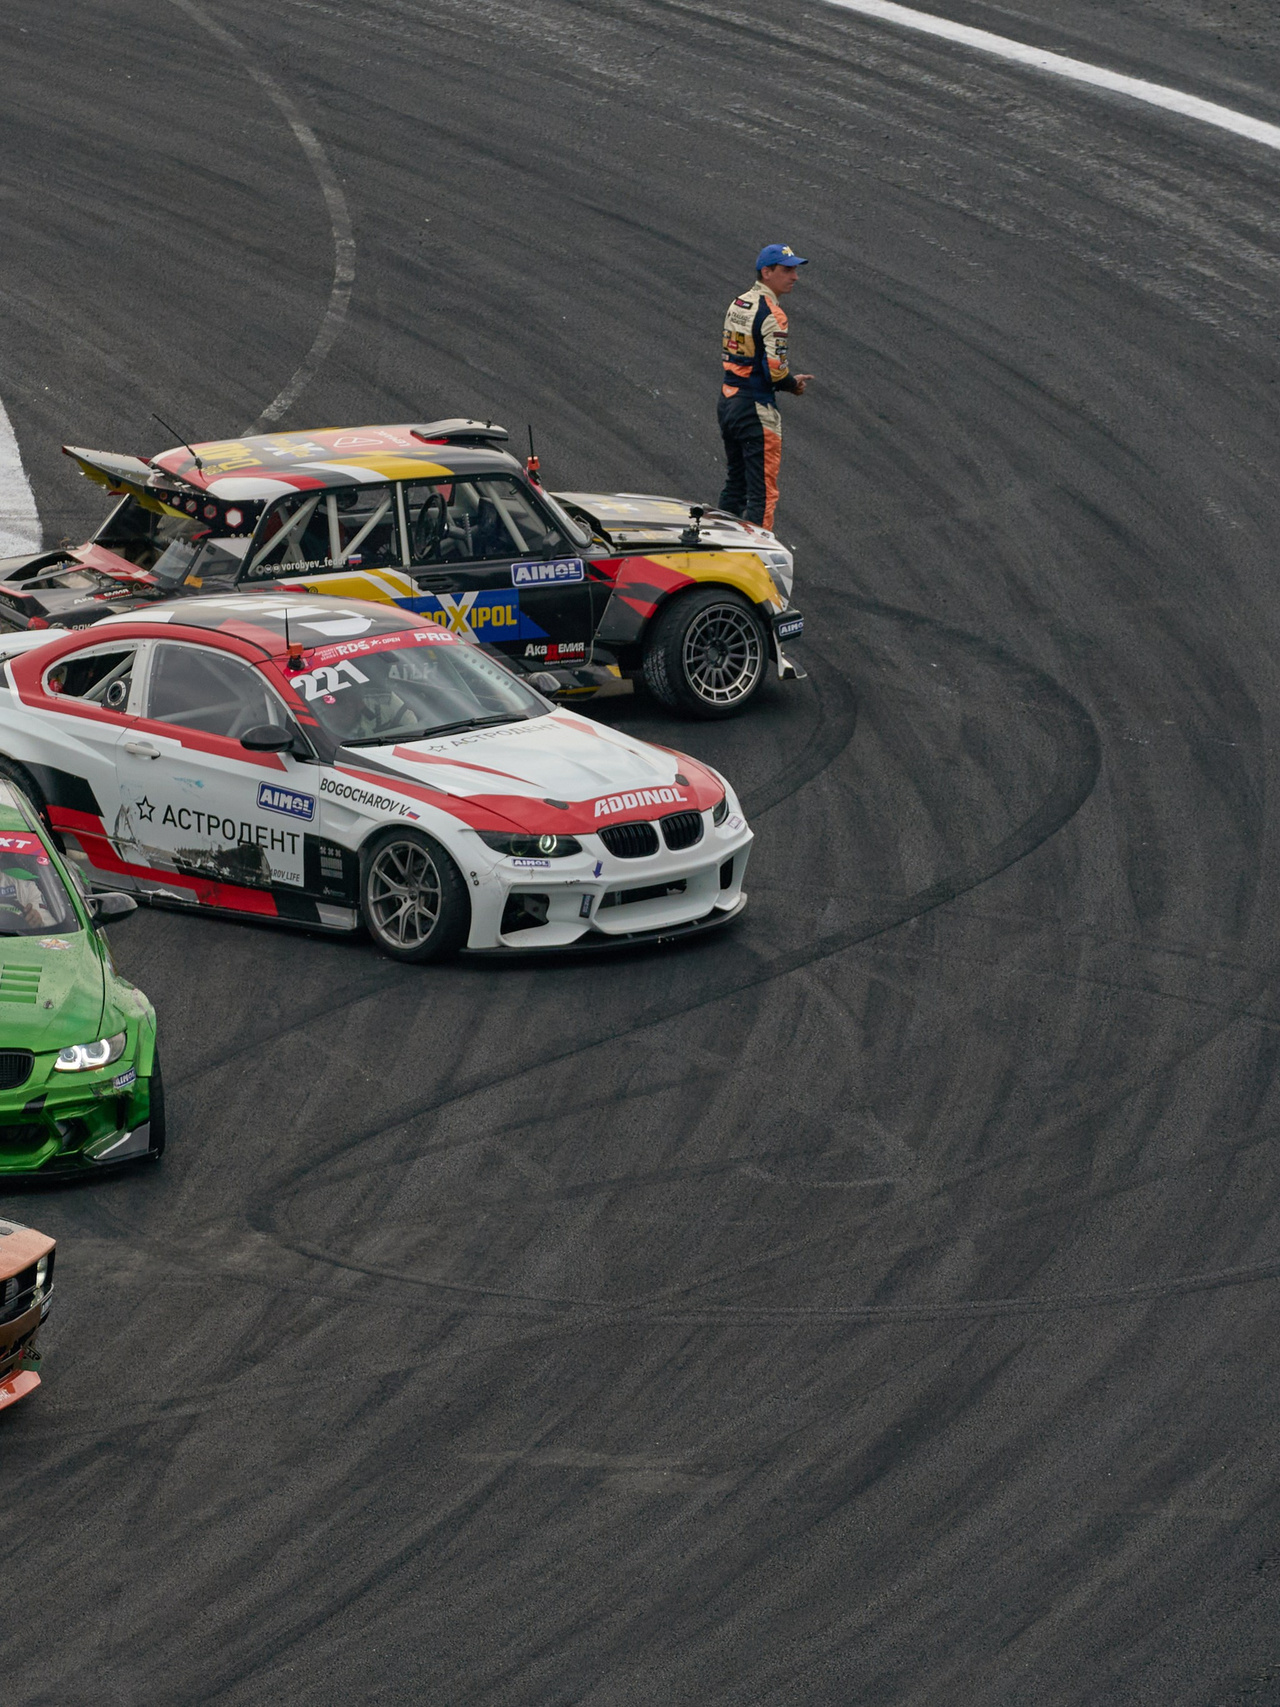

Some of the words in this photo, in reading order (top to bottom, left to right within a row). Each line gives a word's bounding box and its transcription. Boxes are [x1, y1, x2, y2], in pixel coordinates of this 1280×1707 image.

[514, 562, 580, 582] AIMOL
[781, 621, 804, 634] AIMO
[336, 640, 370, 655] RDS
[414, 632, 453, 642] PRO
[289, 659, 370, 701] 221
[450, 722, 561, 747] АСТРОДЕНТ
[260, 789, 313, 815] AIMOL
[320, 778, 398, 812] BOGOCHAROV
[594, 787, 688, 818] ADDINOL
[163, 805, 300, 855] АСТРОДЕНТ
